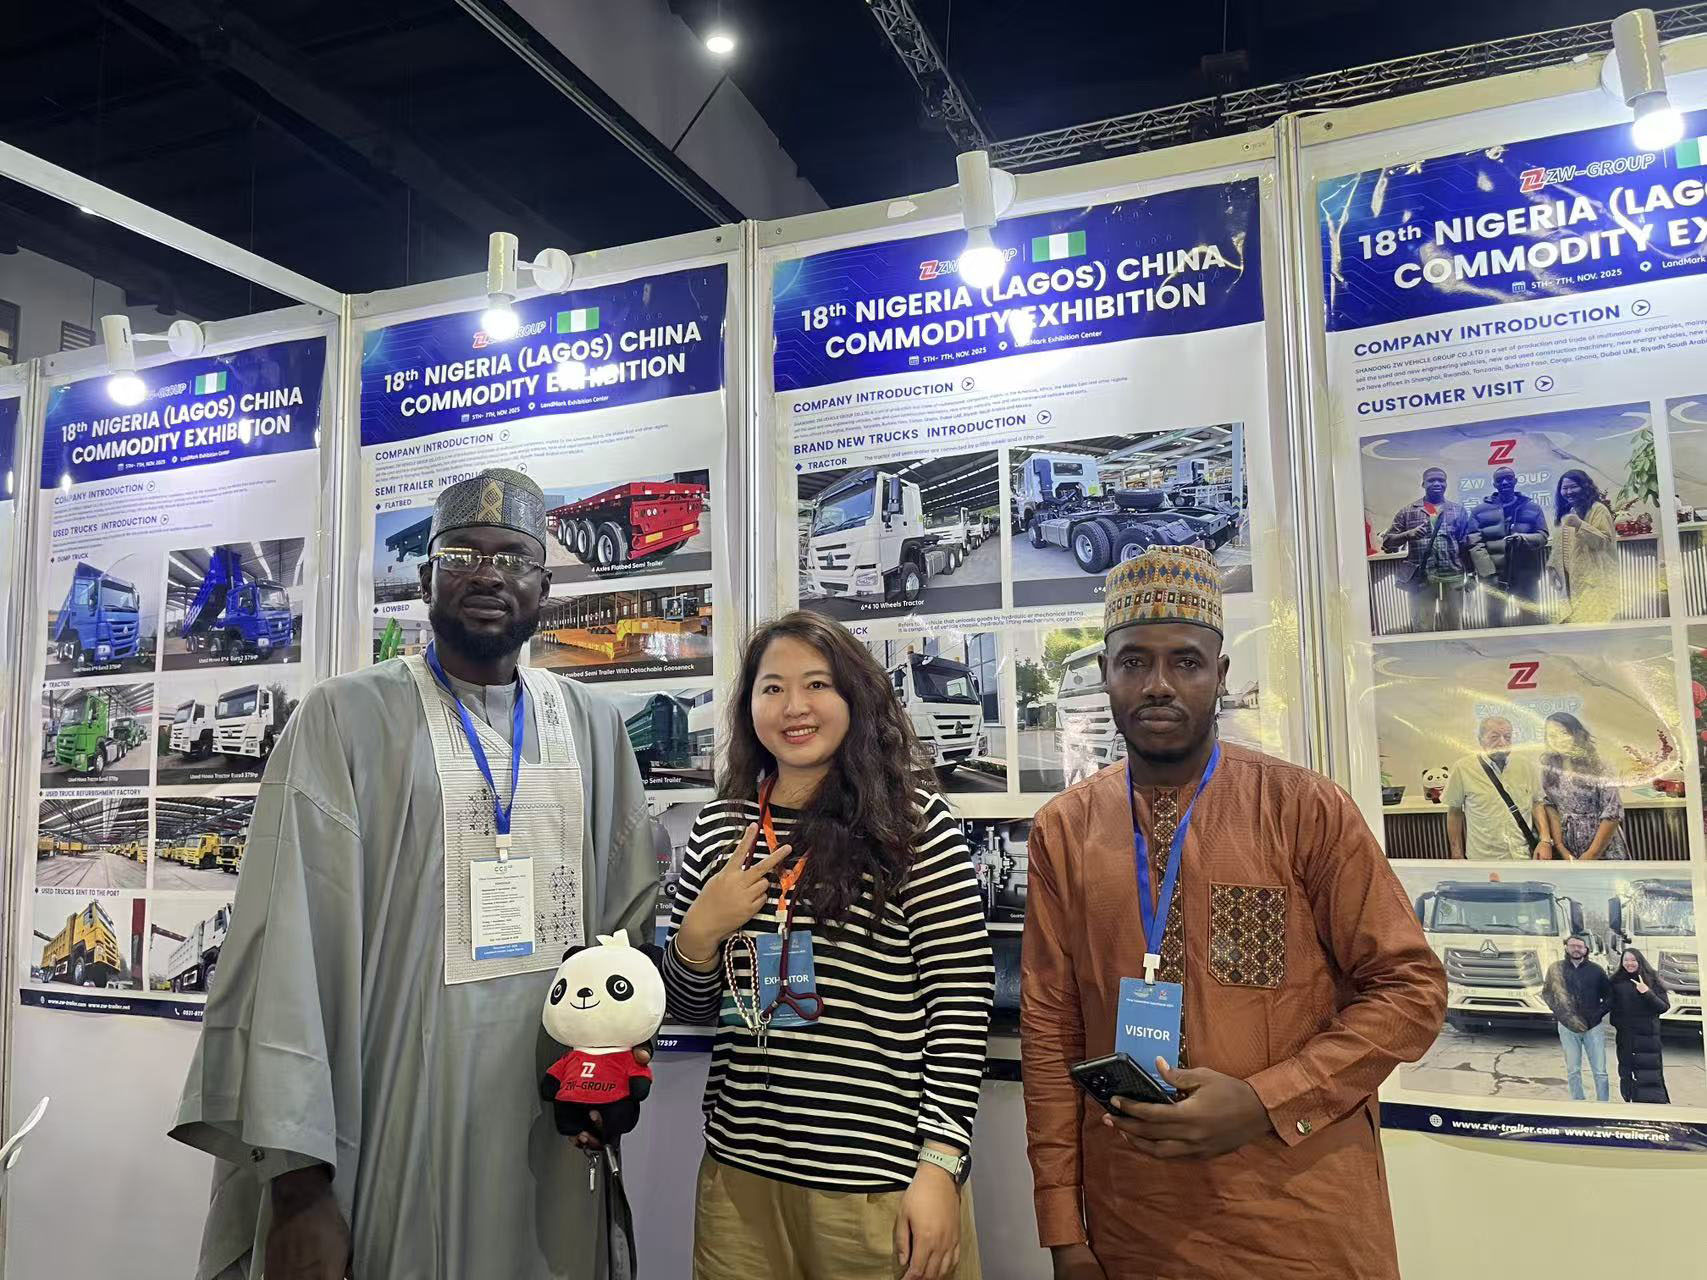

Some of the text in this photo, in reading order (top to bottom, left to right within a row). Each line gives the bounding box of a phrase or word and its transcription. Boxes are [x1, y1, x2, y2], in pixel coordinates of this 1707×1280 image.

[1545, 152, 1655, 185] ZW-GROUP
[1358, 179, 1707, 260] 18th NIGERIA (LAG
[1394, 223, 1655, 290] COMMODITY
[1662, 255, 1707, 269] LandMark
[1577, 272, 1598, 283] NOV.
[1600, 268, 1623, 279] 2025
[801, 244, 1226, 334] 18th NIGERIA (LAGOS) CHINA
[825, 281, 1206, 359] COMMODITY EXHIBITION
[1047, 334, 1080, 344] Exhibition
[1081, 330, 1103, 340] Center
[1354, 304, 1620, 357] COMPANY INTRODUCTION
[383, 320, 702, 394] 18th NIGERIA (LAGOS) CHINA
[971, 346, 987, 356] 2025
[1404, 357, 1431, 367] VEHICLE
[1432, 353, 1456, 362] GROUP
[400, 375, 537, 417] COMMODITY
[568, 397, 592, 406] Exhibition
[592, 395, 609, 403] Center
[793, 394, 853, 413] COMPANY
[856, 382, 954, 403] INTRODUCTION
[1357, 380, 1525, 415] CUSTOMER VISIT
[61, 386, 304, 443] 18th NIGERIA (LAGOS) CHINA
[793, 414, 1026, 455] BRAND NEW TRUCKS INTRODUCTION
[71, 431, 181, 464] COMMODITY
[375, 434, 494, 461] COMPANY INTRODUCTION
[807, 457, 847, 470] TRACTOR
[88, 483, 144, 499] INTRODUCTION
[375, 486, 396, 497] SEMI
[399, 480, 434, 493] TRAILER
[384, 500, 412, 509] FLATBED
[52, 526, 69, 538] USED
[70, 523, 98, 535] TRUCKS
[101, 515, 158, 530] INTRODUCTION
[72, 552, 89, 561] TRUCK
[611, 563, 632, 571] Flatbed
[632, 561, 646, 569] Semi
[382, 604, 410, 613] LOWBED
[880, 601, 902, 609] Wheels
[902, 599, 924, 607] Tractor
[849, 626, 868, 635] UCK
[584, 670, 598, 678] Semi
[616, 667, 630, 675] With
[630, 665, 663, 674] Detachable
[663, 663, 695, 672] Gooseneck
[115, 788, 142, 797] FACTORY
[764, 974, 810, 985] EXHITOR
[1125, 1024, 1170, 1041] VISITOR
[564, 1080, 616, 1092] ZW-GROUP
[1451, 1118, 1671, 1143] www.zw-trailer.com www.zw-trailer.net
